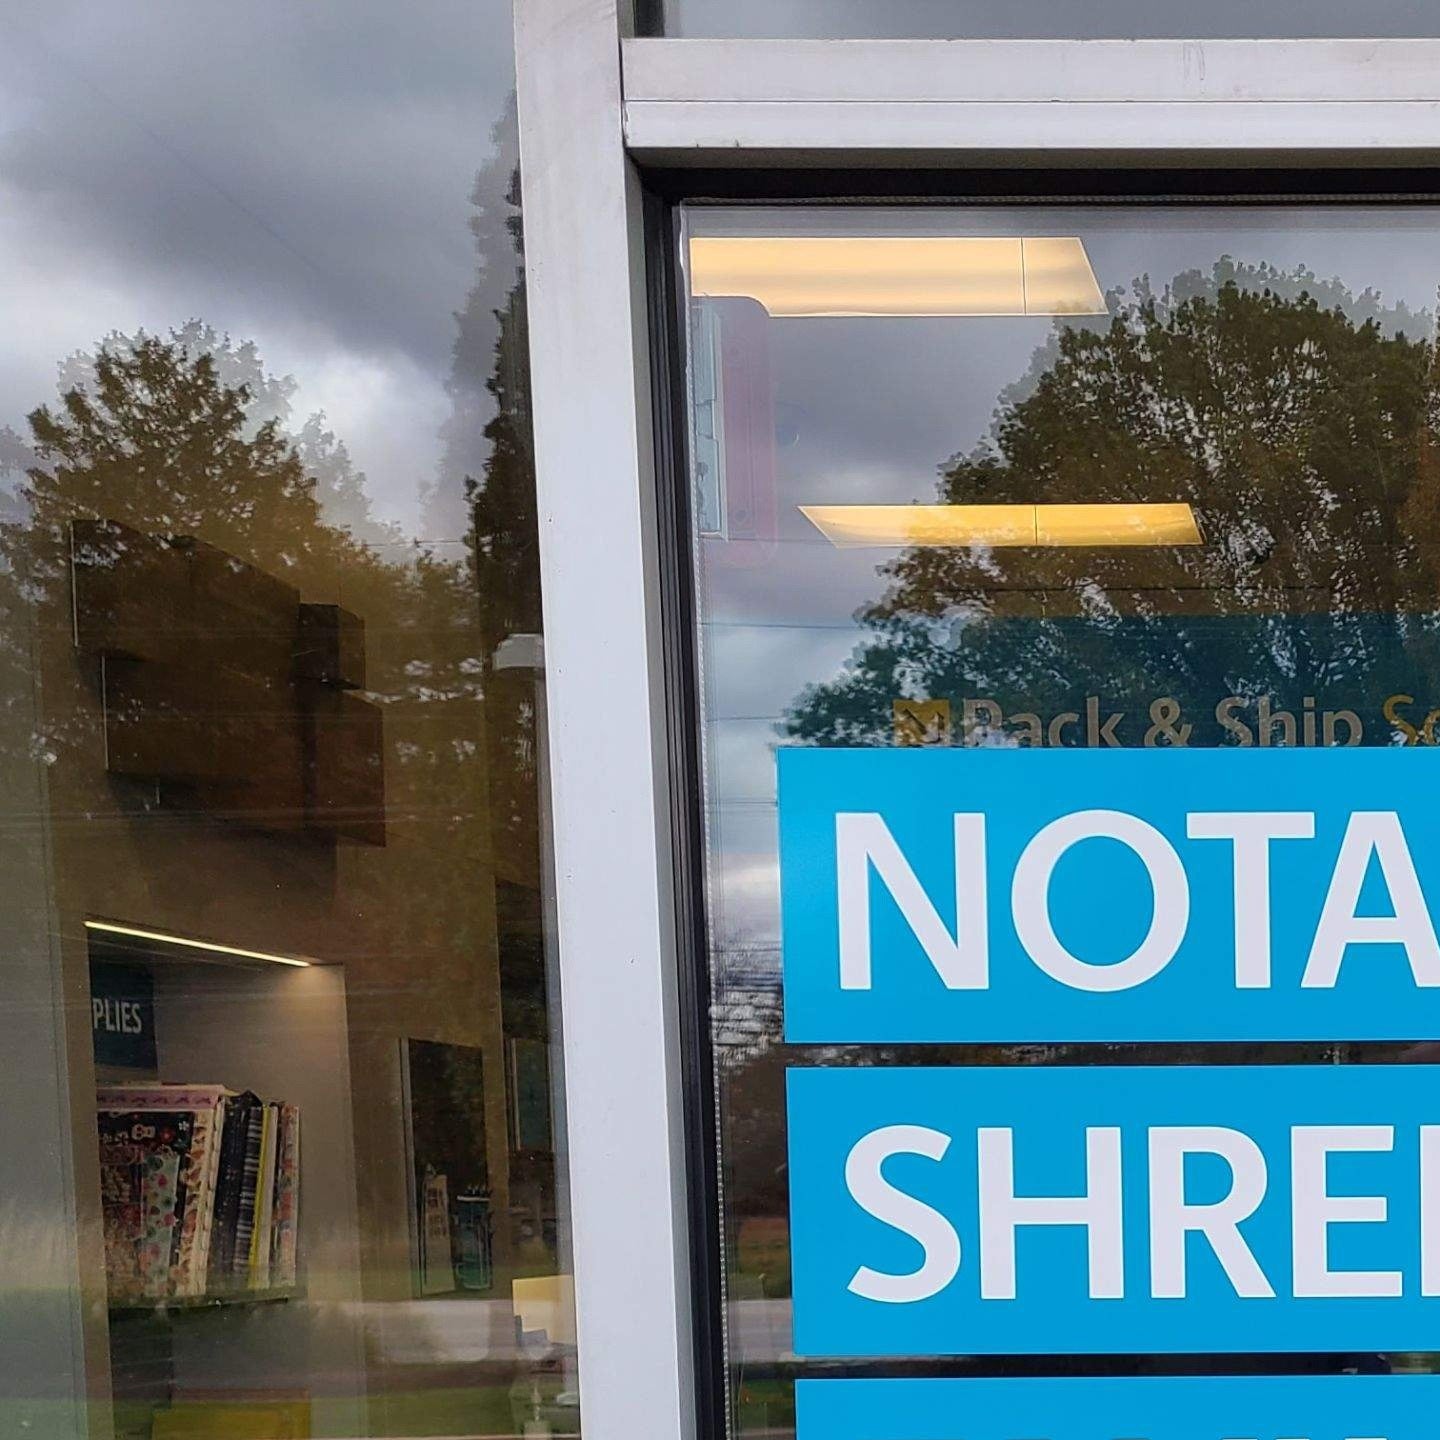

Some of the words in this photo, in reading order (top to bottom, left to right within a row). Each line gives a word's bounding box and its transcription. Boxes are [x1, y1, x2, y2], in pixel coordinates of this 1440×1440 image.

[961, 695, 1125, 747] Pack
[1144, 697, 1193, 747] &
[1214, 696, 1363, 747] Ship
[92, 997, 142, 1034] PLIES
